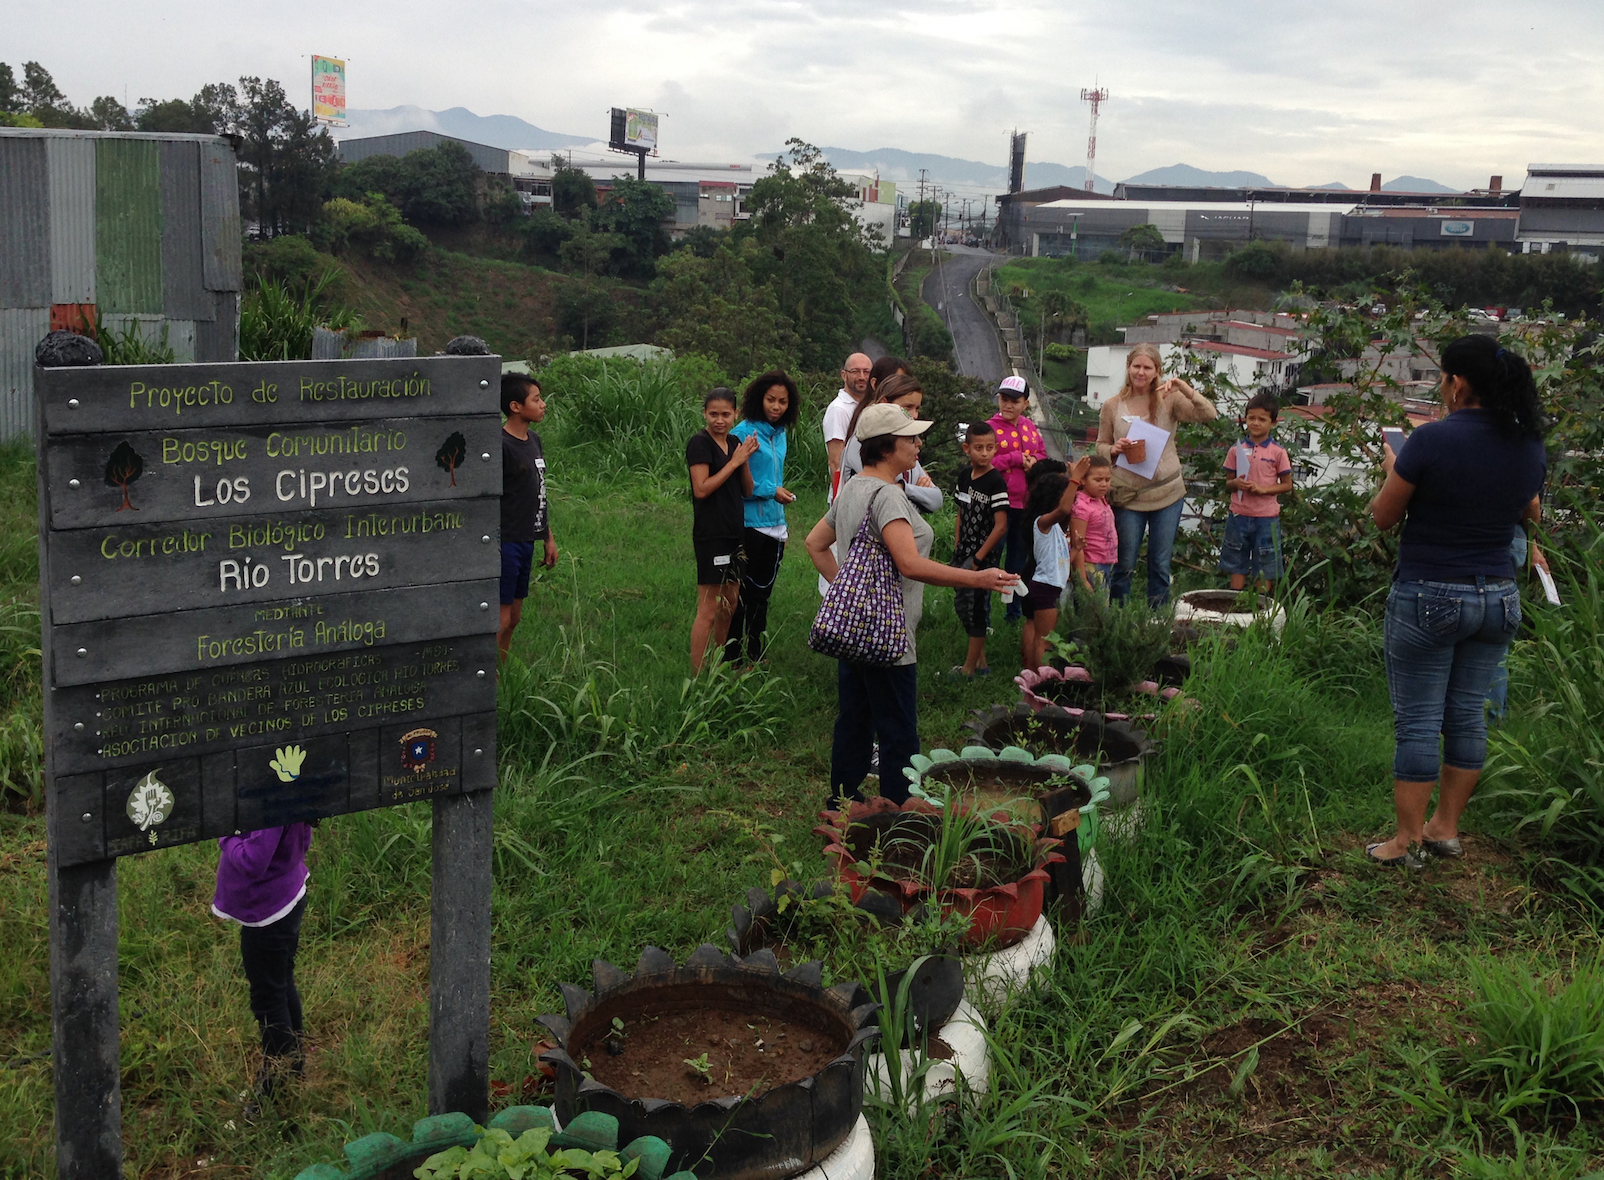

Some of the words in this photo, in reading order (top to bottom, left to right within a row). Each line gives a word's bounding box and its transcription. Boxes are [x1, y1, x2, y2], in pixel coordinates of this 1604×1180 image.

[129, 380, 233, 414] Proyecto
[252, 377, 278, 404] de
[300, 371, 432, 402] Restauración
[162, 436, 248, 466] Bosque
[266, 427, 408, 459] Comunitario
[193, 474, 252, 507] Los
[275, 465, 410, 507] Cipreses
[101, 530, 212, 560] Corredor
[228, 519, 326, 552] Biológico
[343, 508, 467, 539] Interurbano
[281, 552, 381, 585] Torres
[254, 604, 325, 622] MEDIANTE
[197, 624, 306, 661] Forestería
[315, 619, 387, 647] Análoga
[101, 678, 179, 703] PROGRAMA
[102, 699, 163, 722] COMITE
[172, 695, 200, 711] PRO
[278, 680, 311, 697] AZUL
[102, 730, 198, 759] ASOCIACION
[205, 727, 221, 742] DE
[229, 716, 293, 738] VECINOS
[301, 711, 317, 728] DE
[323, 706, 349, 724] LOS
[357, 695, 426, 719] CIPRESES
